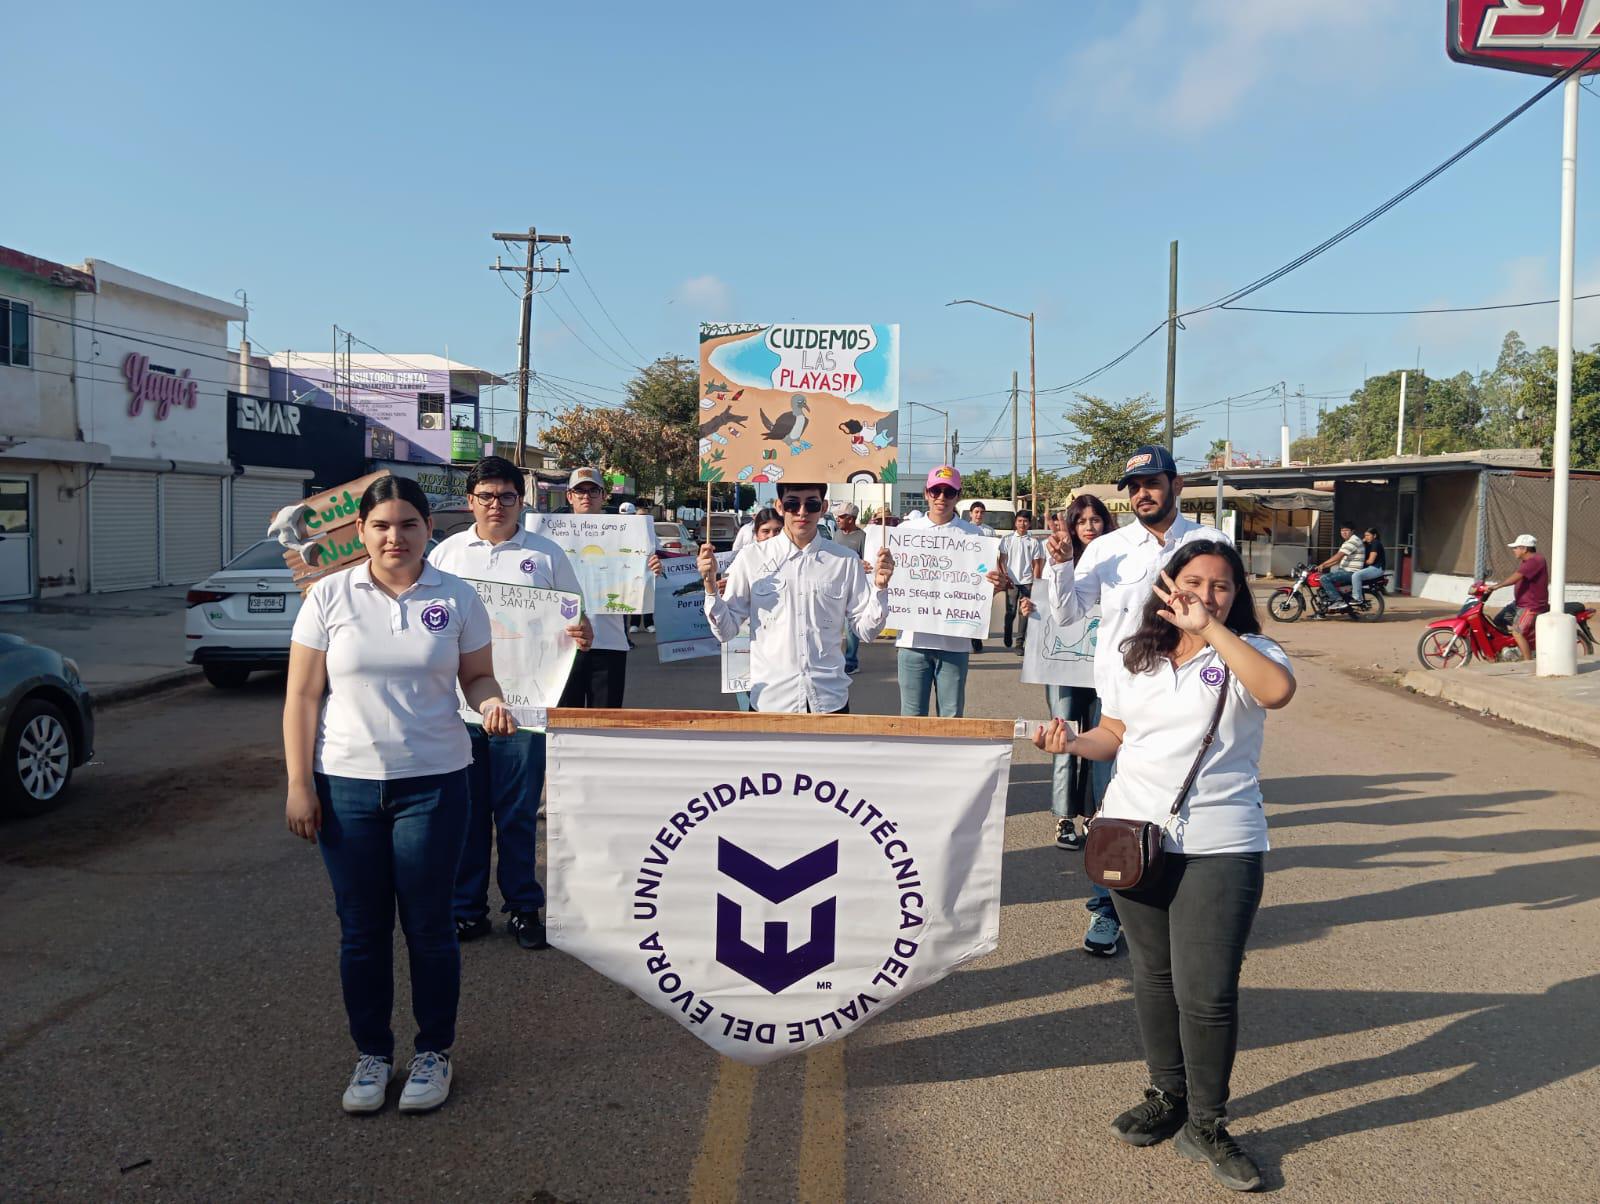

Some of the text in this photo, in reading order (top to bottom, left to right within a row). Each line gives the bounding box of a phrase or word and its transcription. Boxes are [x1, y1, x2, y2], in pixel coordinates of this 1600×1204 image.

[770, 328, 870, 350] CUIDEMOS
[801, 350, 837, 371] LAS
[397, 372, 429, 384] DENTAL
[779, 368, 857, 392] PLAYAS!!
[888, 533, 983, 553] NECESITAMOS
[909, 569, 982, 586] LIMPIAS
[476, 582, 560, 603] EN LAS ISLAS
[887, 588, 906, 598] ARA
[909, 588, 941, 600] SEGUIR
[500, 595, 536, 611] SANTA
[677, 600, 693, 609] Por
[917, 606, 929, 615] EN
[946, 607, 981, 620] ARENA
[633, 772, 924, 1045] UNIVERSIDAD POLITÉCNICA DEL VALLE DEL ÉVORA
[816, 981, 833, 990] MR
